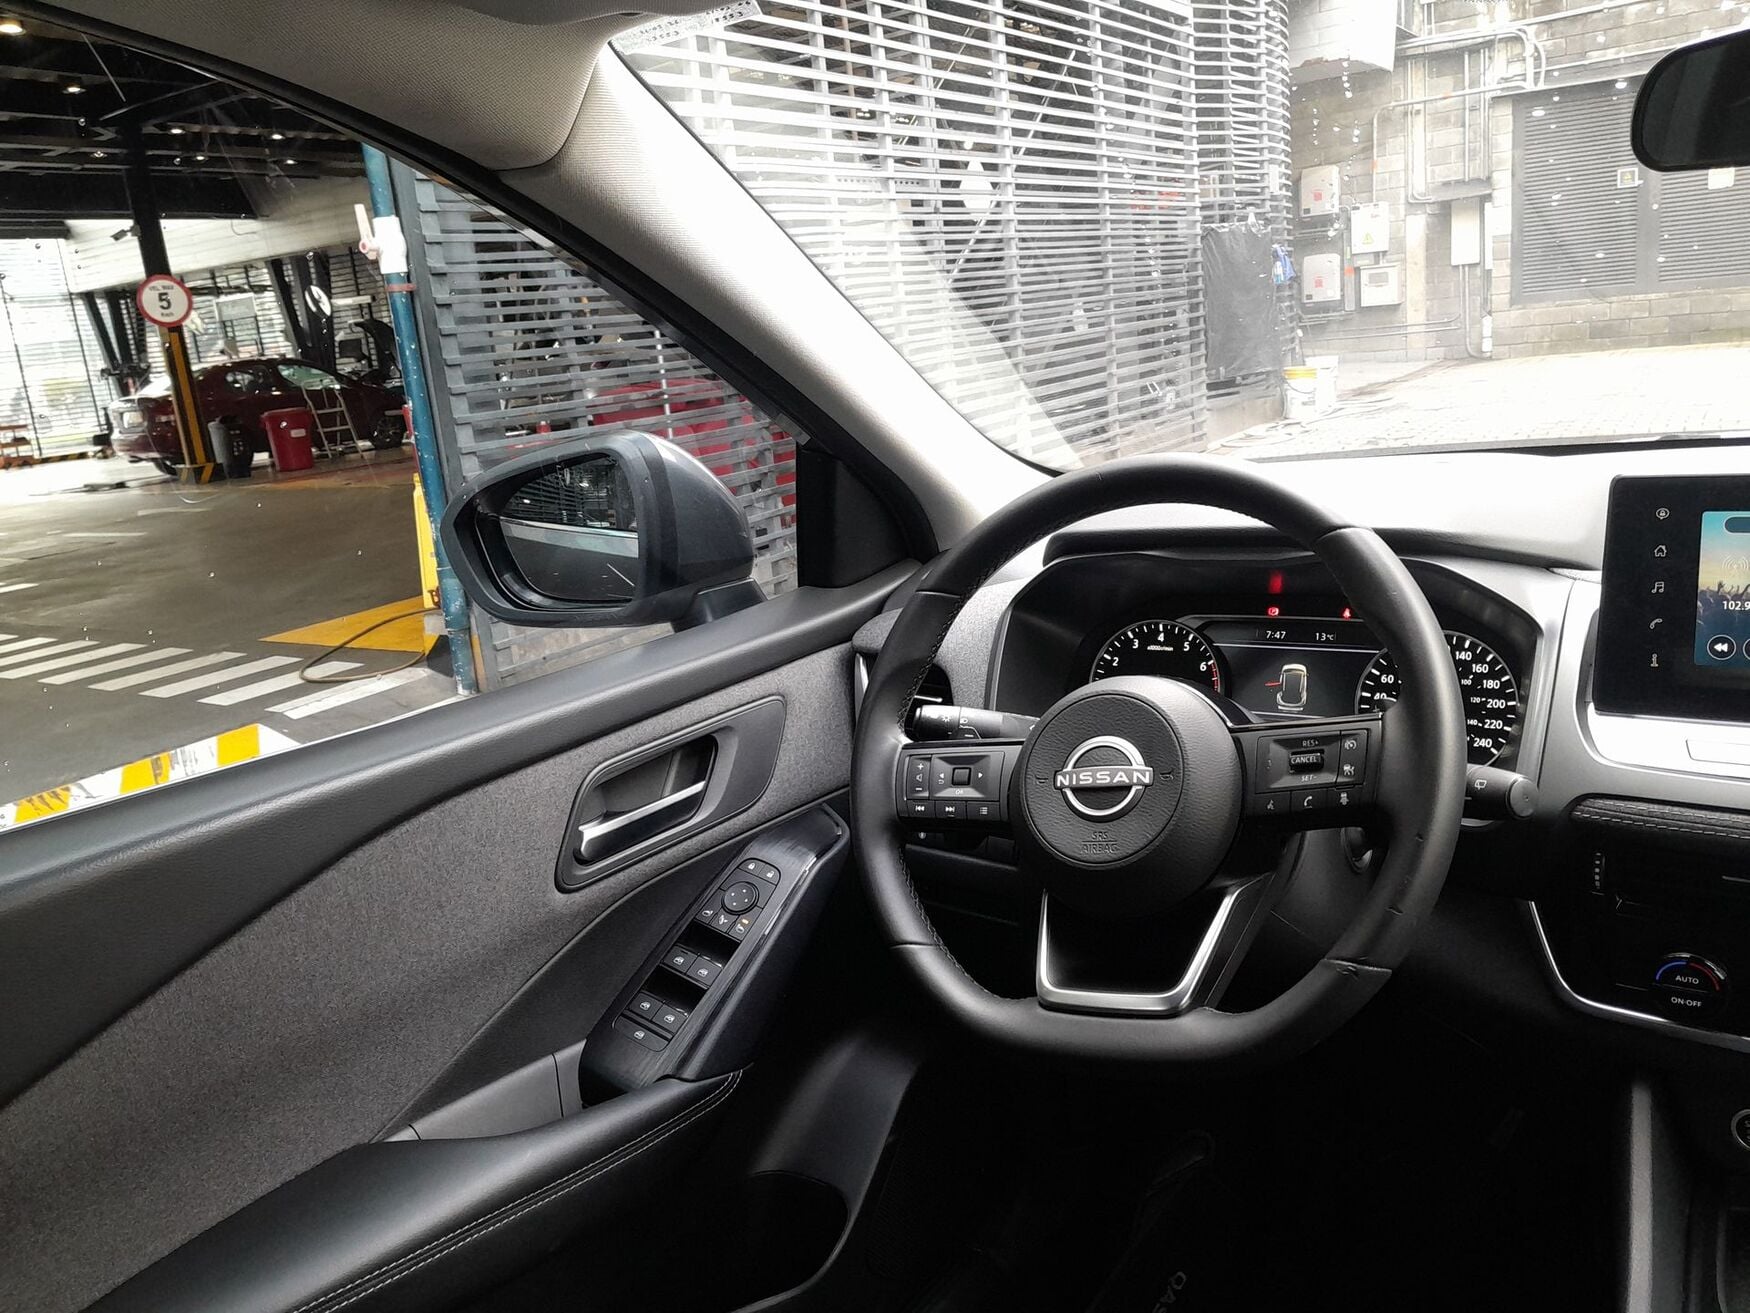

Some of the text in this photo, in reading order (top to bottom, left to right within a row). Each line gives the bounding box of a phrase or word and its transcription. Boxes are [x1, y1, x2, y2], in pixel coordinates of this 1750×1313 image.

[158, 292, 171, 310] 5
[1157, 632, 1165, 642] 4
[1266, 630, 1286, 639] 7:47
[1132, 639, 1139, 649] 3
[1183, 641, 1190, 652] 5
[1112, 656, 1119, 666] 2
[1455, 651, 1472, 661] 140
[1199, 662, 1207, 672] 6
[1472, 664, 1489, 673] 160
[1380, 674, 1394, 684] 60
[1483, 679, 1500, 689] 180
[1486, 699, 1506, 709] 200
[1484, 719, 1503, 729] 220
[1303, 739, 1319, 747] RES+
[1473, 738, 1493, 748] 240
[1291, 755, 1317, 765] CANCEL
[1057, 771, 1150, 787] NISSAN
[1091, 831, 1108, 840] SRS
[1675, 975, 1699, 985] AUTO
